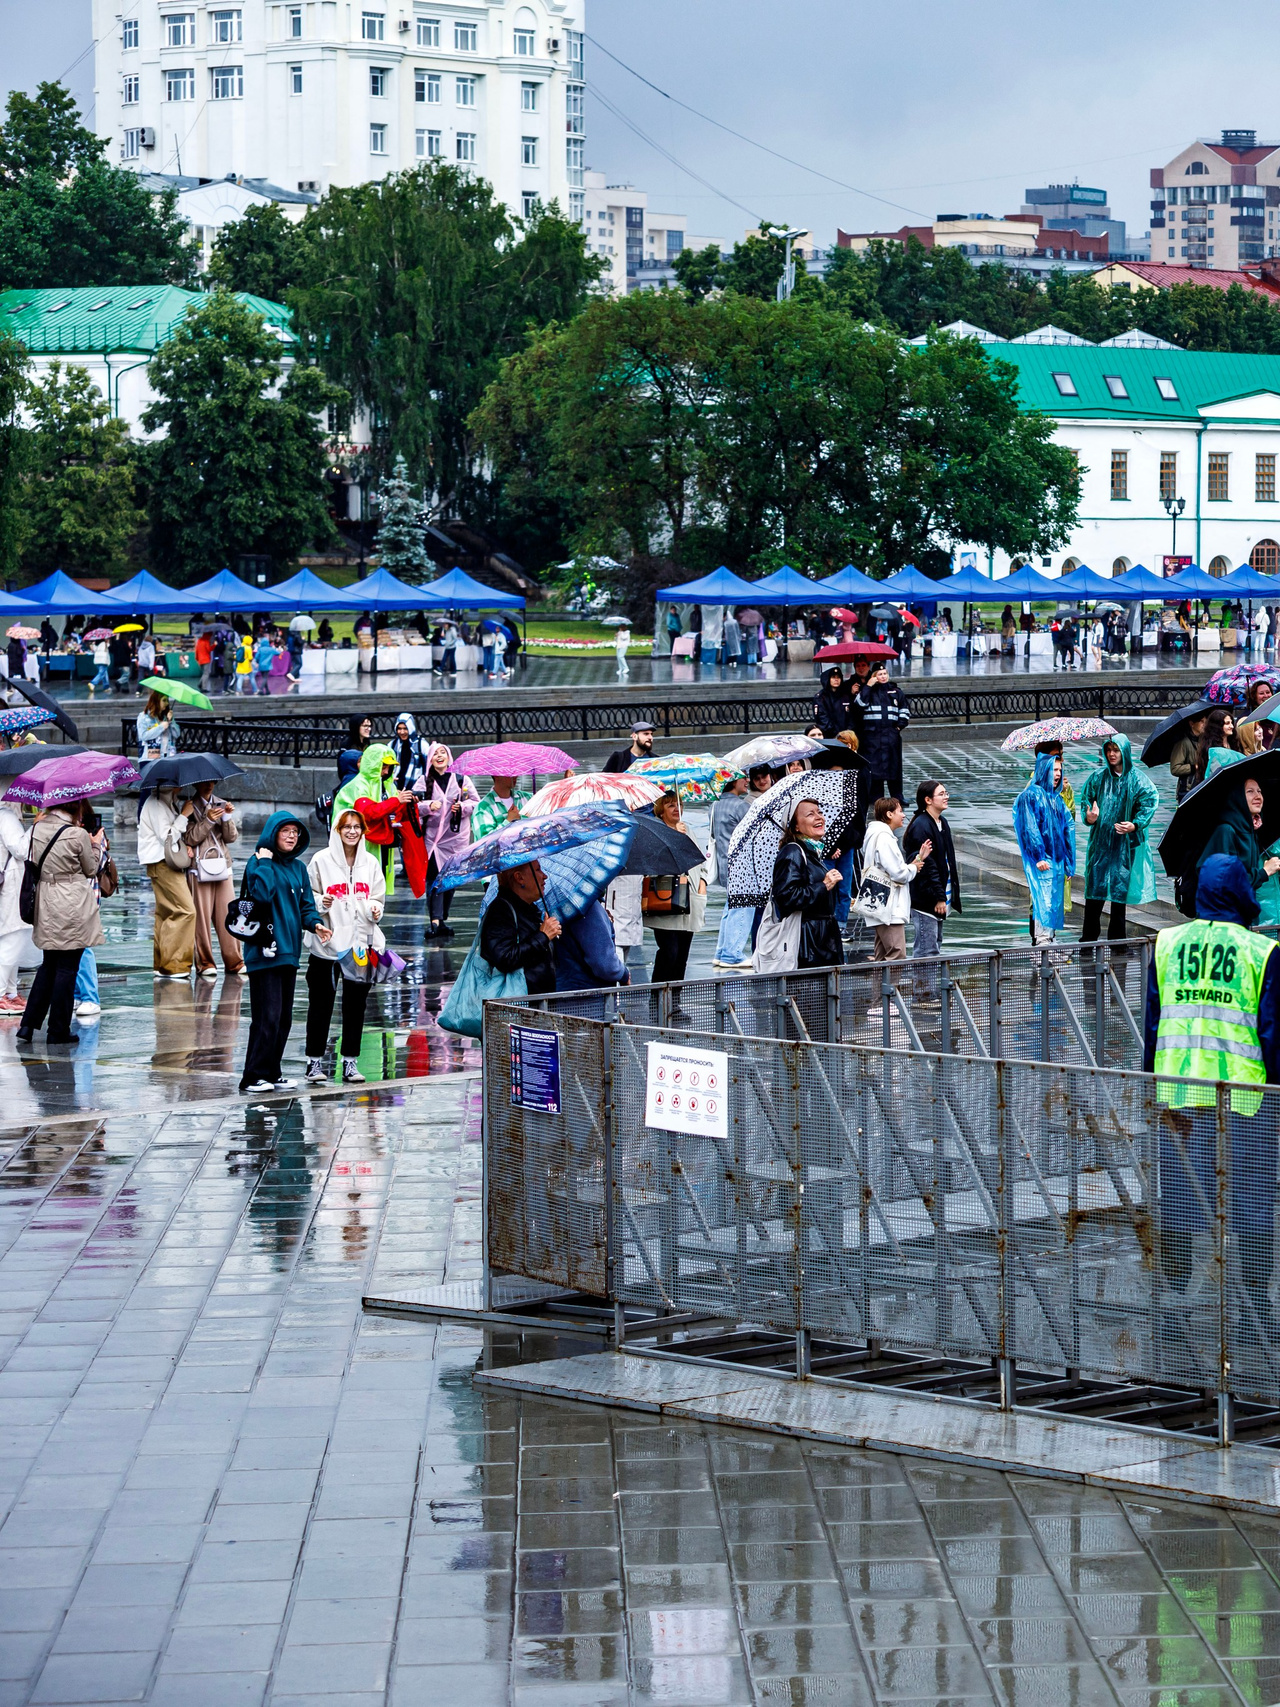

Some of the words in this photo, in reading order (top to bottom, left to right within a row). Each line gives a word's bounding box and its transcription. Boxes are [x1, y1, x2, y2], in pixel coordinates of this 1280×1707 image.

[1178, 943, 1236, 983] 15126
[1175, 989, 1233, 1003] STEWARD
[547, 1102, 558, 1112] 112
